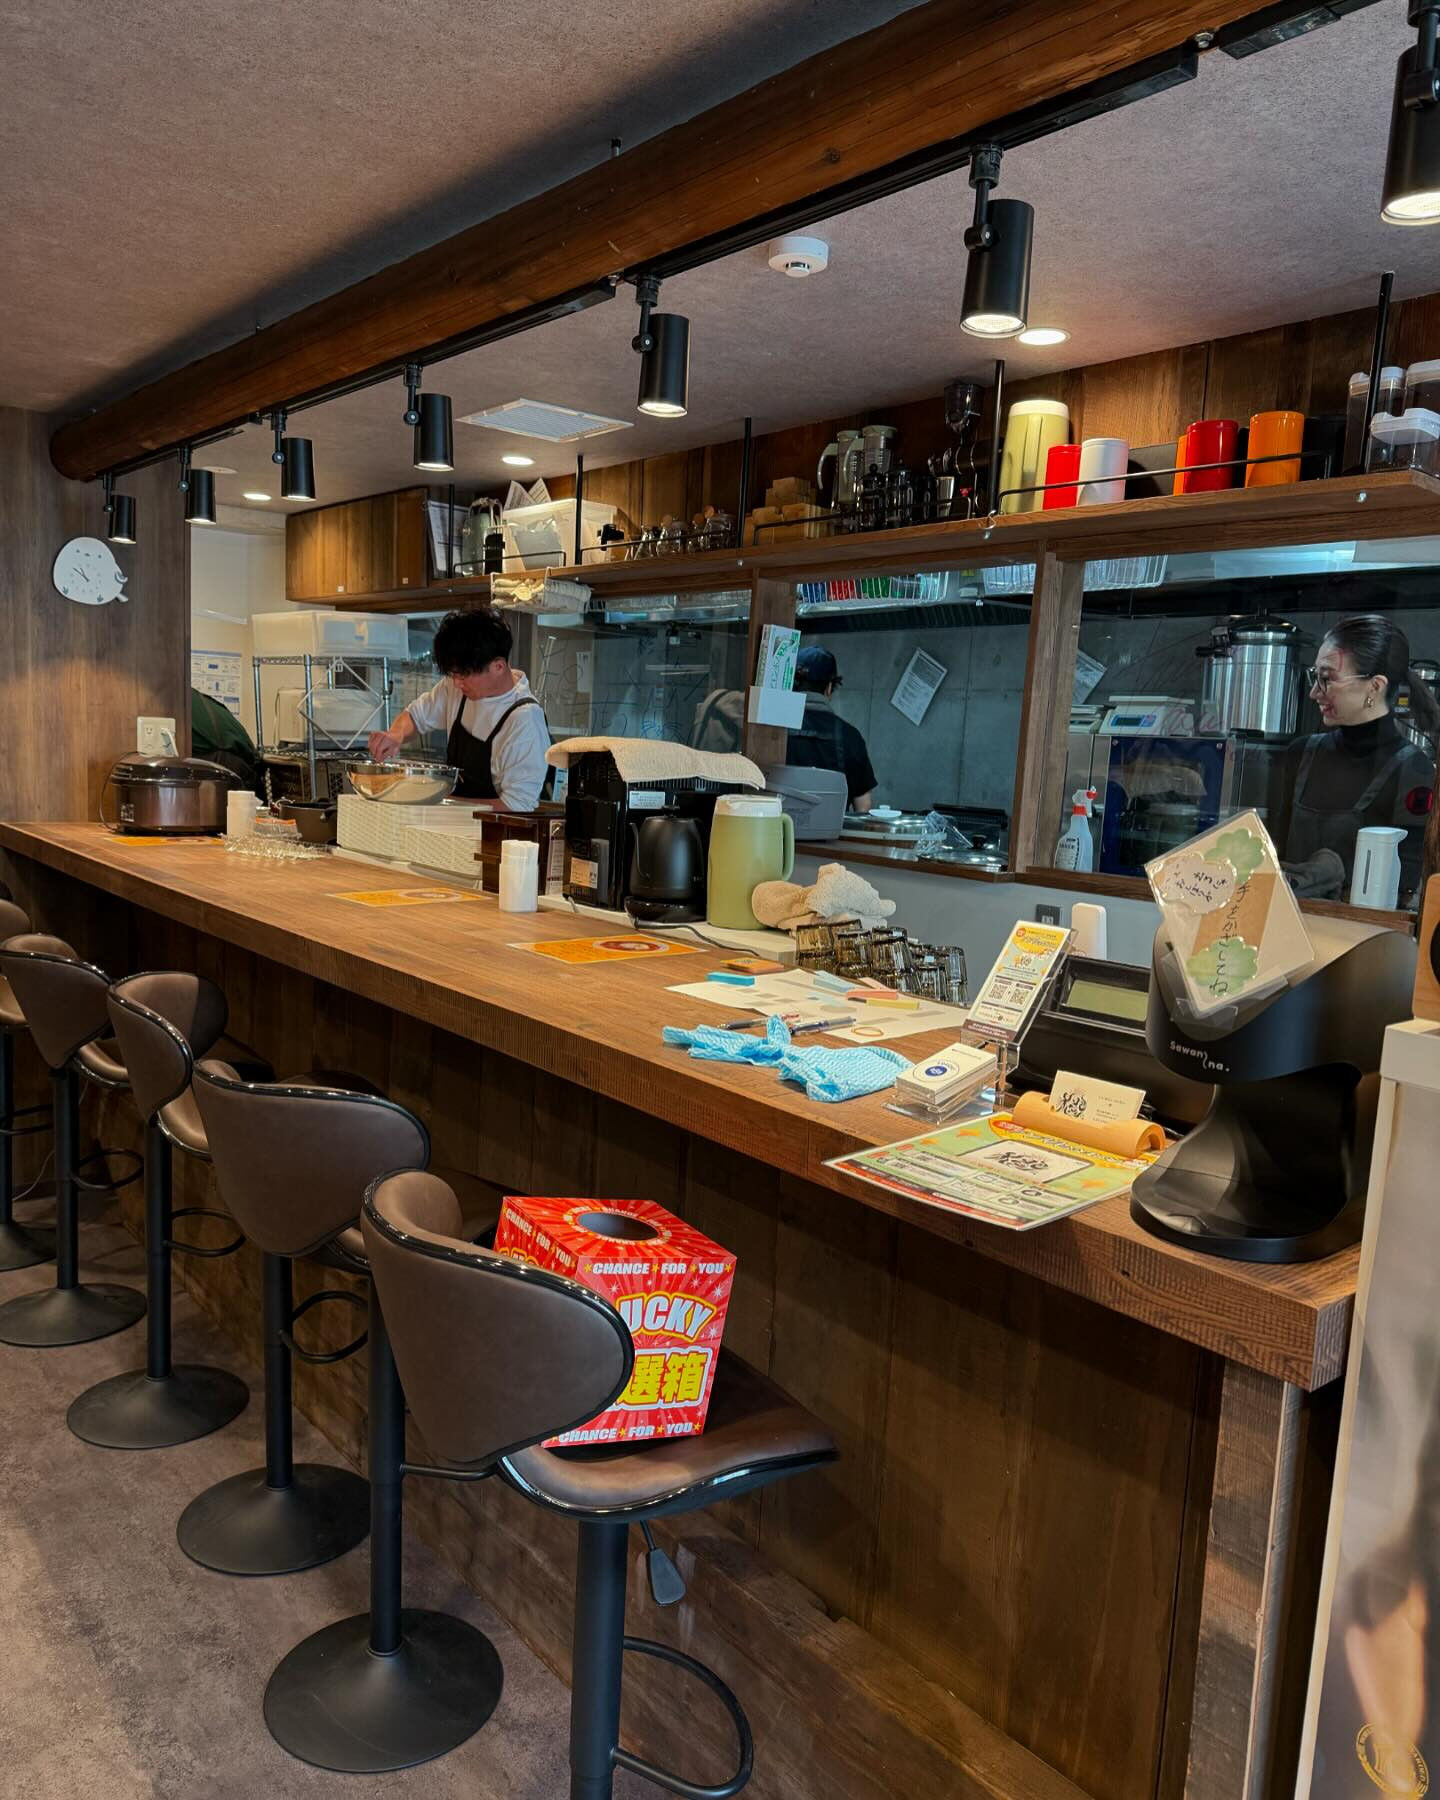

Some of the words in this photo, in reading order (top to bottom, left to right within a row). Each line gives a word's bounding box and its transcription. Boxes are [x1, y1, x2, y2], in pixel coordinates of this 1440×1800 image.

[1209, 882, 1253, 993] 手をかざしてね
[506, 1208, 533, 1236] CHANCE
[536, 1232, 551, 1251] FOR
[555, 1246, 572, 1267] YOU
[592, 1262, 650, 1274] CHANCE
[661, 1263, 687, 1274] FOR
[699, 1263, 725, 1273] YOU
[618, 1294, 714, 1339] UCKY
[615, 1351, 709, 1406] 選箱
[558, 1427, 617, 1443] CHANCE
[628, 1425, 654, 1437] FOR
[667, 1422, 693, 1434] YOU
